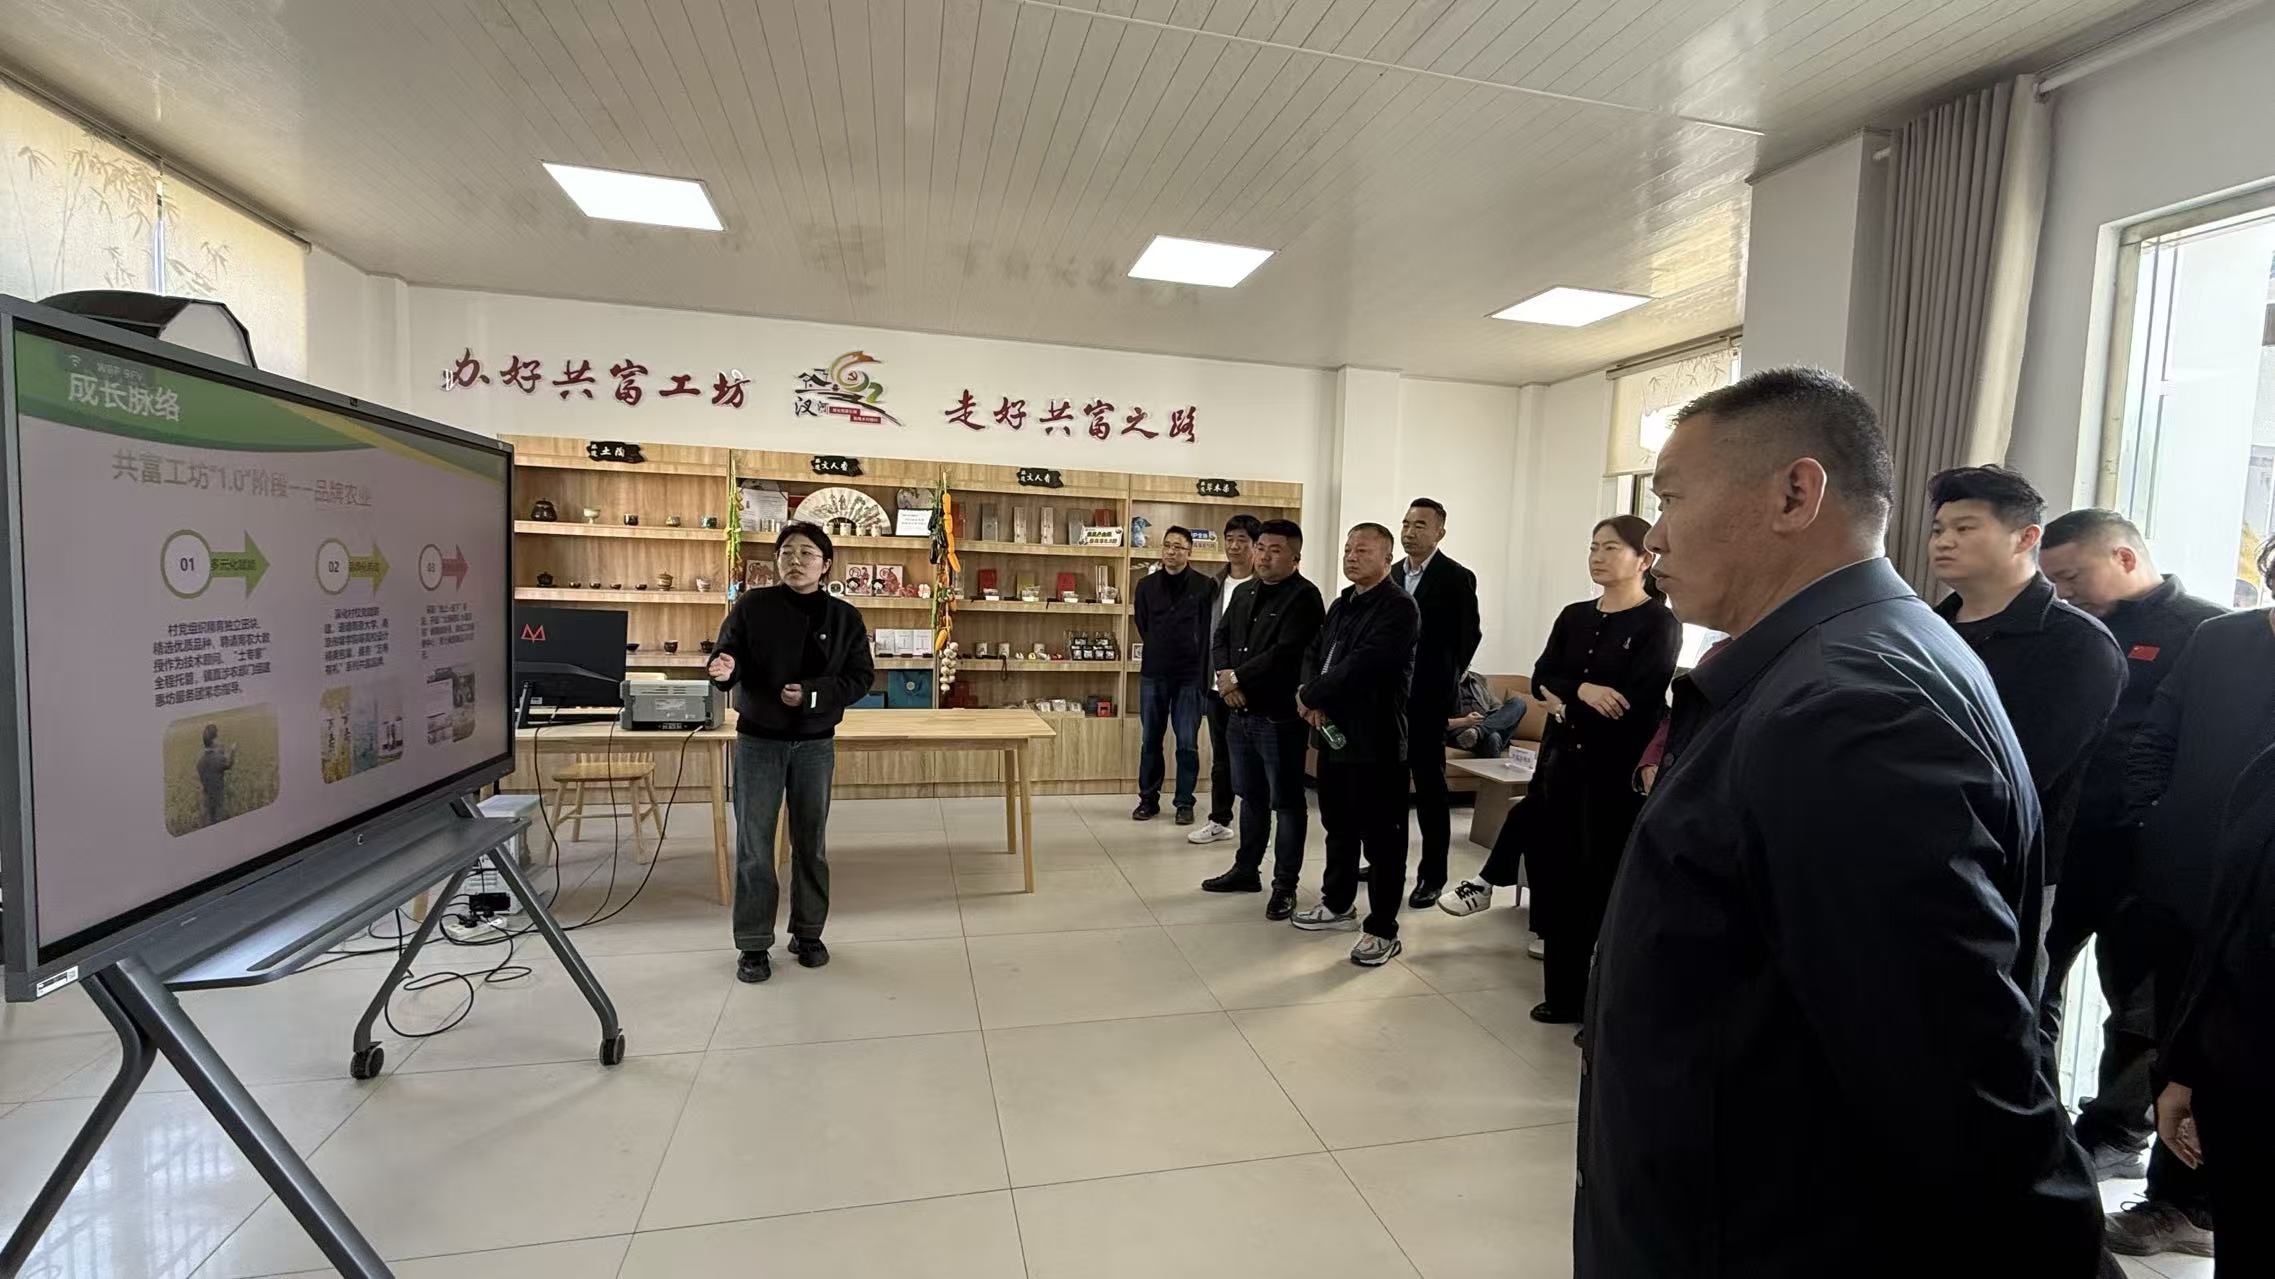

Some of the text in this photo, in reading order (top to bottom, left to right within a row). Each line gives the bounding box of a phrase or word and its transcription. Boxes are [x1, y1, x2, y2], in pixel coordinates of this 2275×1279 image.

[68, 371, 180, 422] 成长脉络
[443, 348, 751, 409] 办好共富工坊
[945, 389, 1197, 443] 走好共富之路
[180, 557, 195, 572] 01
[328, 560, 340, 573] 02
